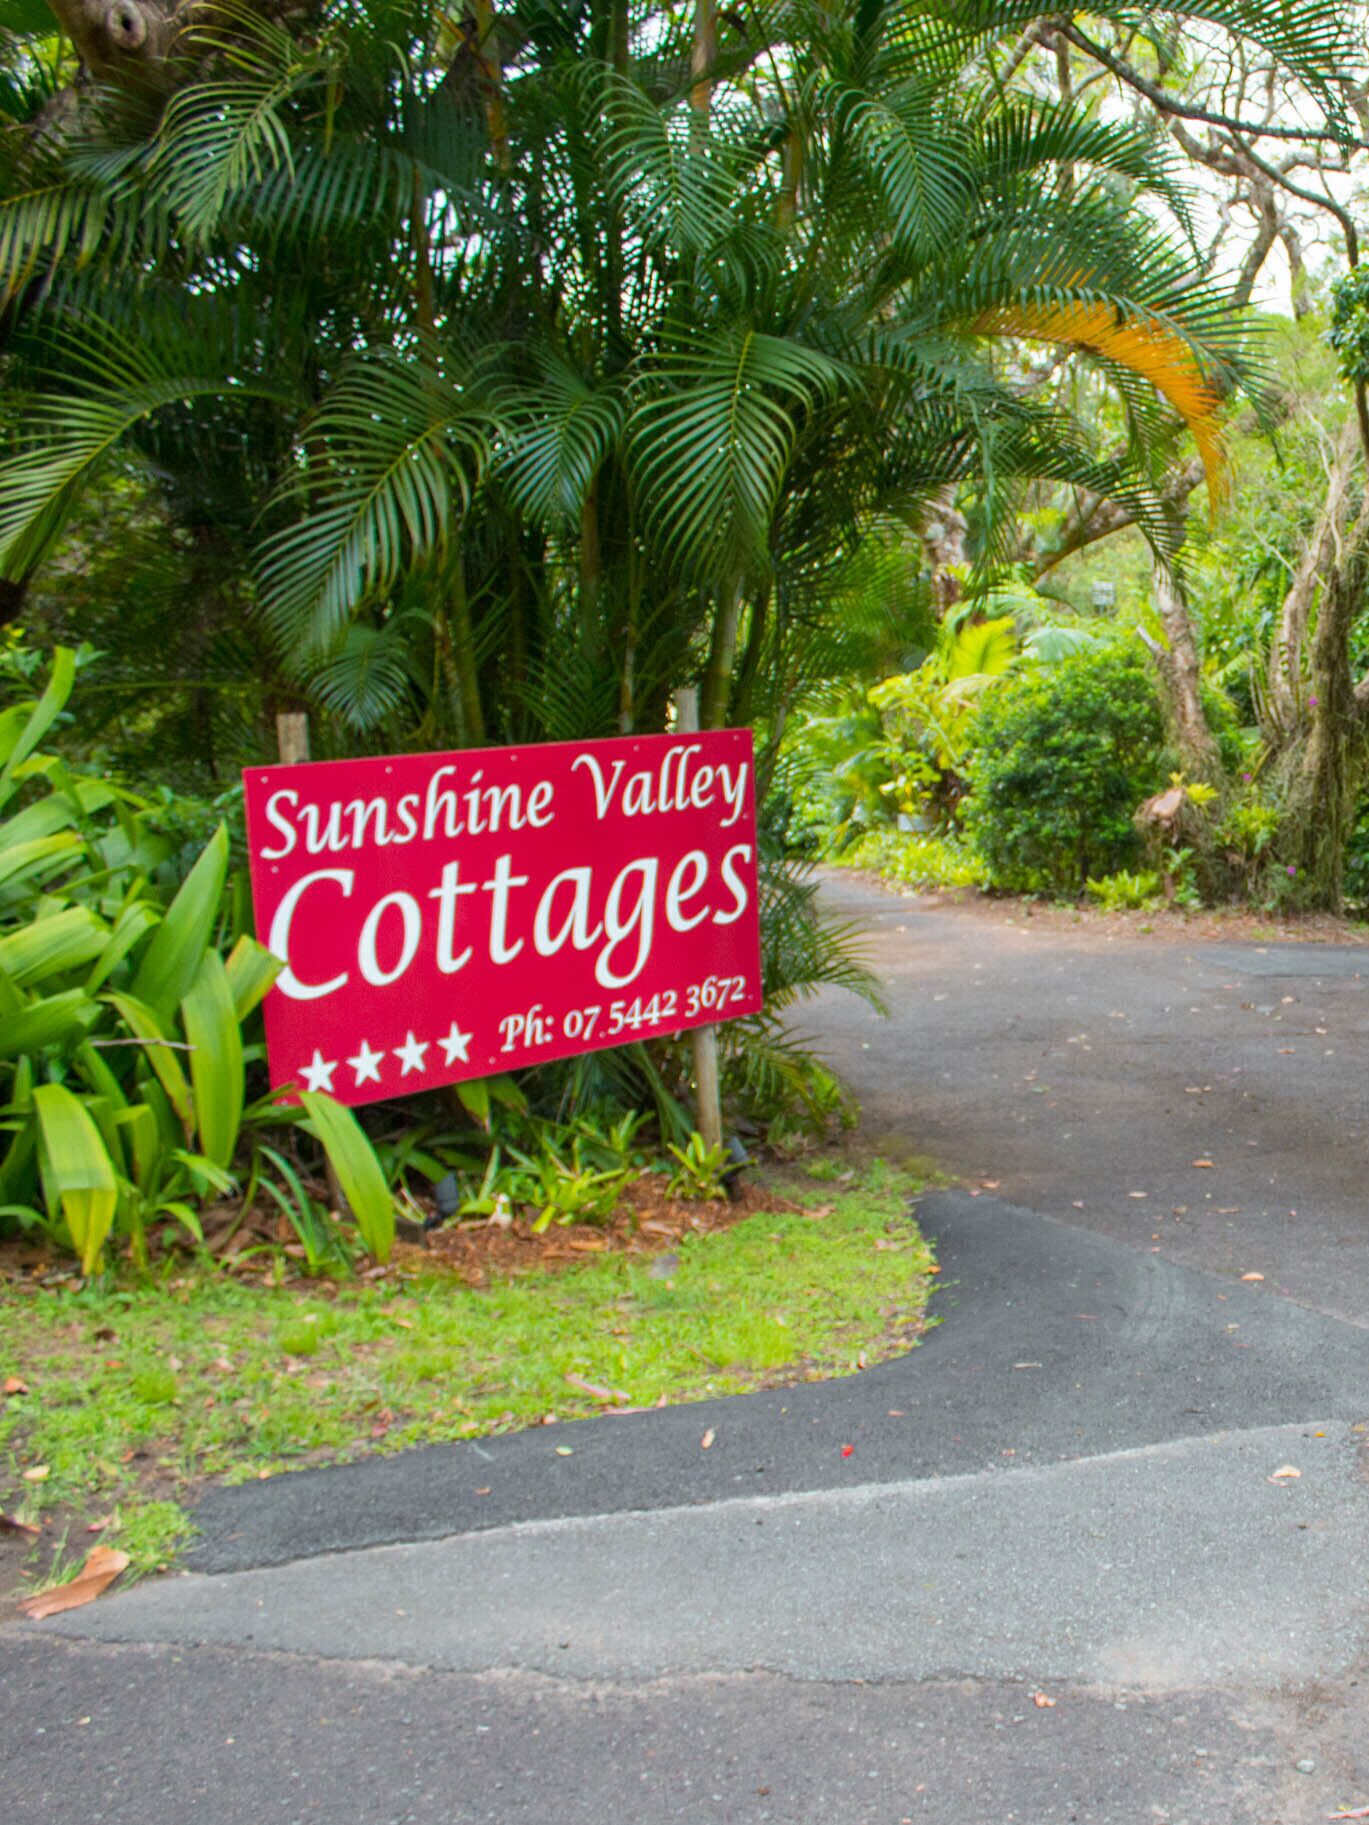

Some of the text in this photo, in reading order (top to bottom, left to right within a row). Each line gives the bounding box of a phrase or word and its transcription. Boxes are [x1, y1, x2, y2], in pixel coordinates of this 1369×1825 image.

[260, 744, 748, 860] Sunshine Valley
[267, 843, 752, 1001] Cottages
[498, 975, 746, 1053] Ph: 07 5442 3672
